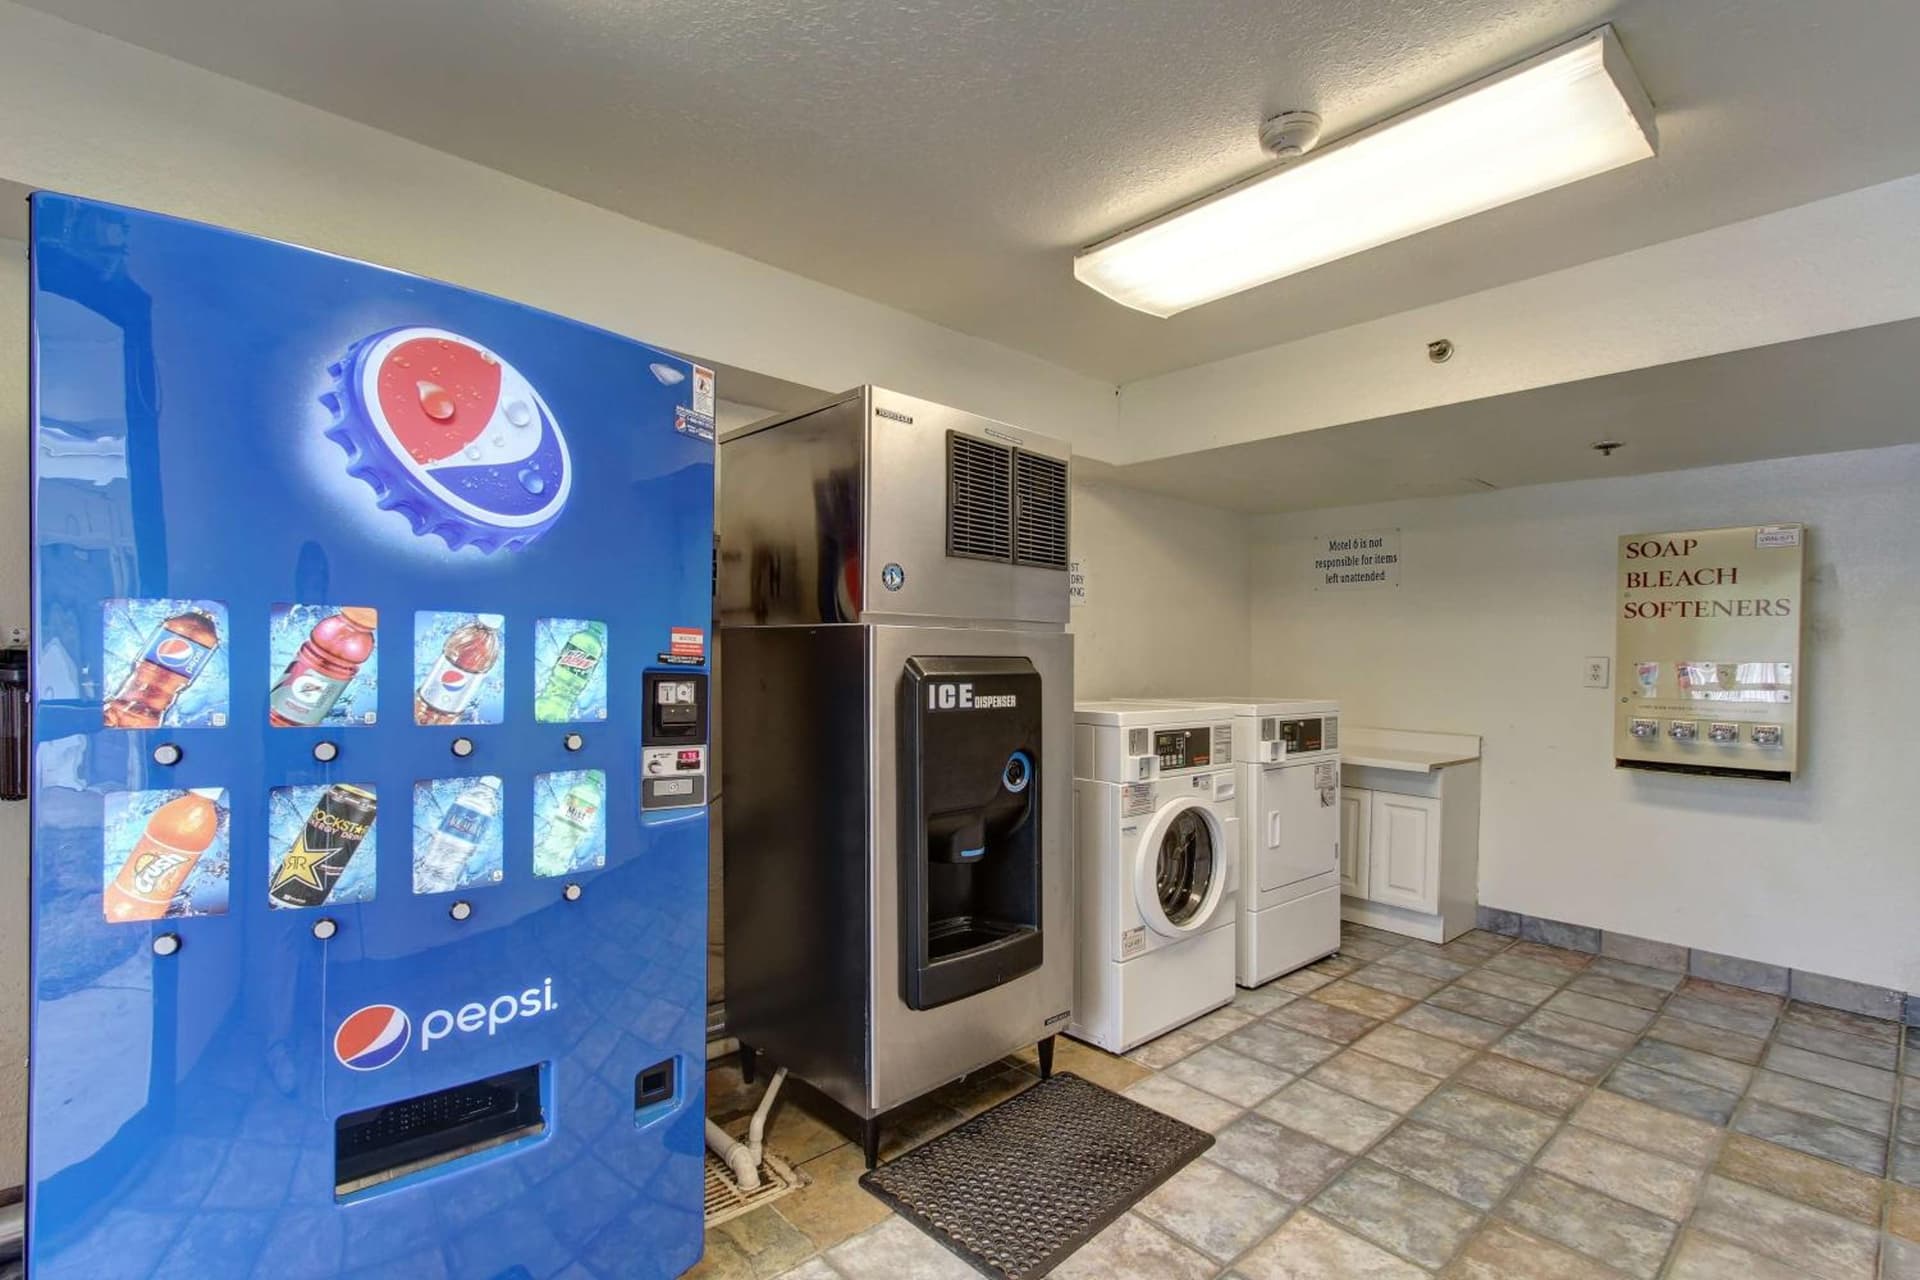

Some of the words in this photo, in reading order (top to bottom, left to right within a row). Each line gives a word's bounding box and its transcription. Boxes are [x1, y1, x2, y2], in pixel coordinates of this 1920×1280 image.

[1328, 539, 1351, 551] Motel
[1352, 539, 1359, 549] 6
[1360, 538, 1367, 549] is
[1369, 537, 1383, 549] not
[1626, 539, 1698, 560] SOAP
[1315, 555, 1359, 570] responsible
[1361, 554, 1373, 566] for
[1374, 554, 1398, 565] items
[1326, 573, 1339, 584] left
[1340, 570, 1386, 583] unattended
[1627, 567, 1739, 589] BLEACH
[1624, 598, 1792, 619] SOFTENERS
[928, 683, 973, 709] ICE
[974, 695, 1017, 709] DISPENSER
